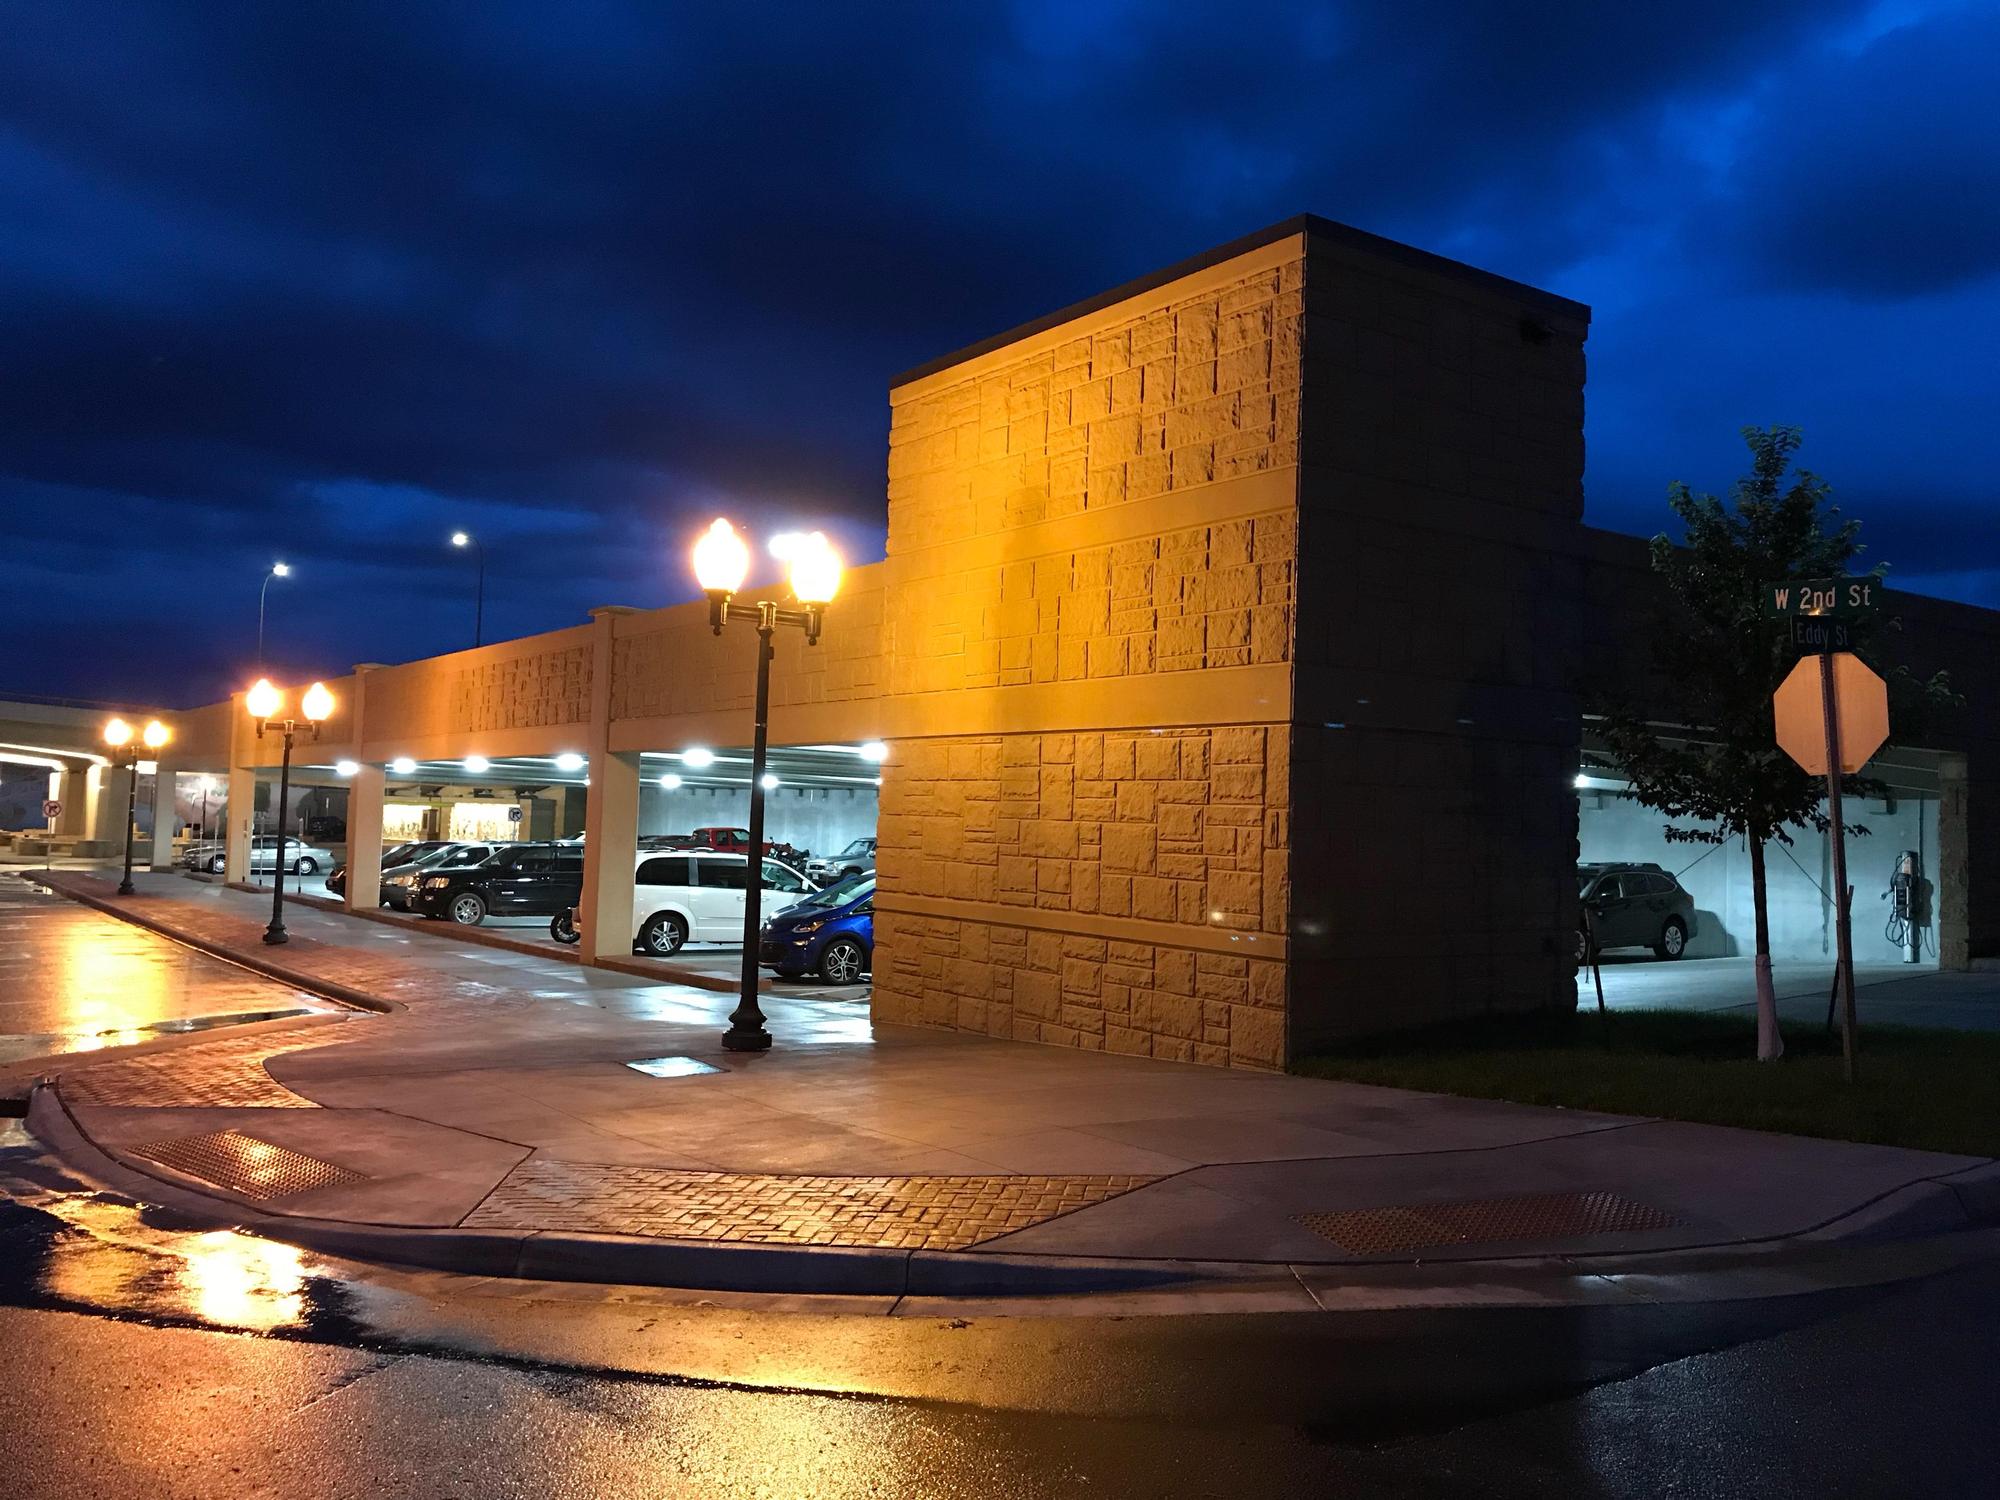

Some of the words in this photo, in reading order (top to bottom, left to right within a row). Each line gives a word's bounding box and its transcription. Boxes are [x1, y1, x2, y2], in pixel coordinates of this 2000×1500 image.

[1774, 588, 1789, 610] W
[1799, 586, 1836, 609] 2nd
[1848, 584, 1872, 607] St
[1796, 622, 1829, 649] Eddy
[1835, 624, 1849, 646] St
